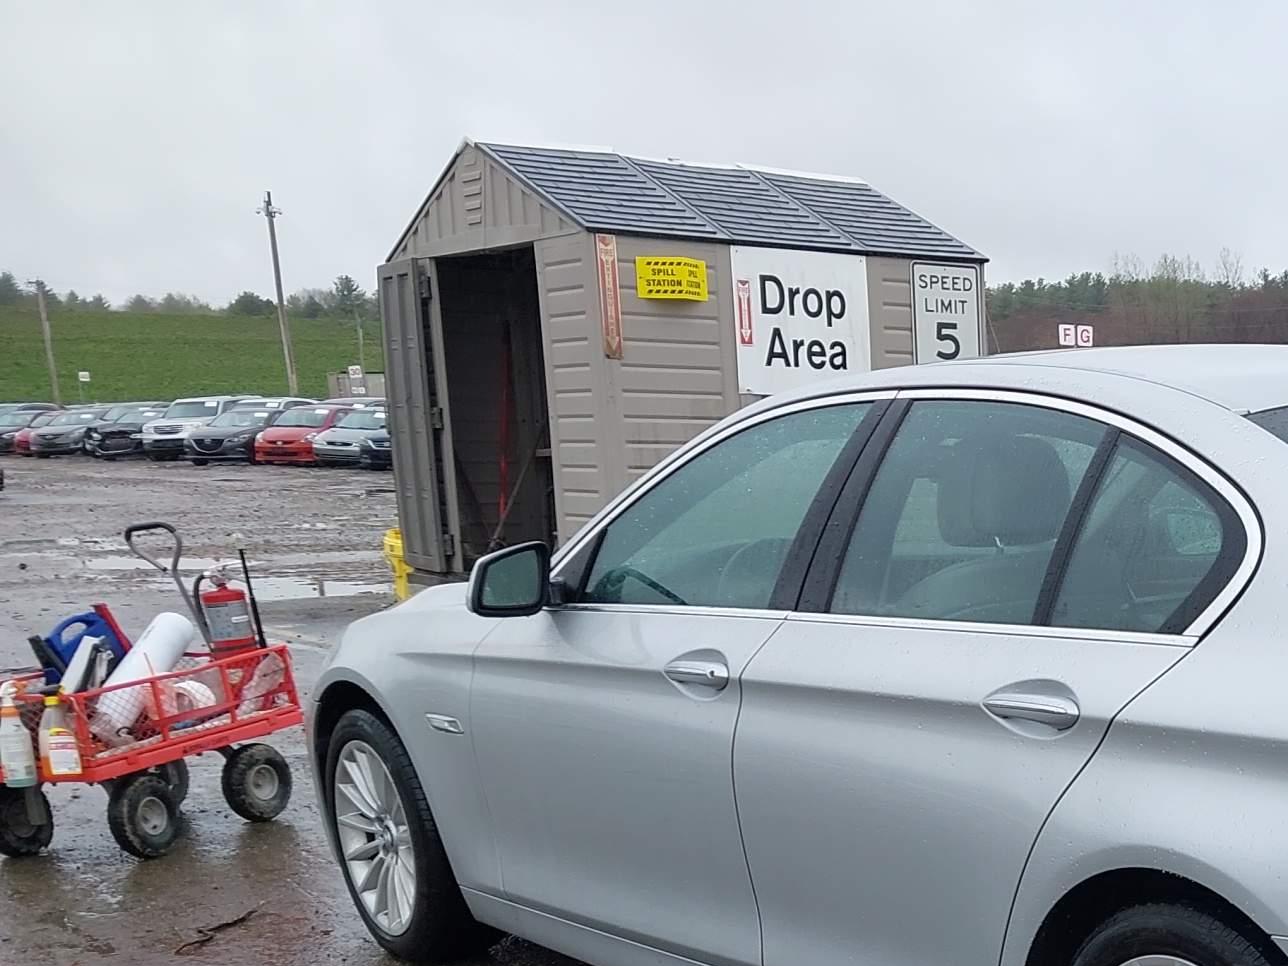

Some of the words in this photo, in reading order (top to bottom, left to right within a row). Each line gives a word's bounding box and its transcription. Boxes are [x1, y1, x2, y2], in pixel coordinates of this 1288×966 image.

[651, 268, 676, 276] SPILL
[646, 279, 682, 287] STATION
[918, 273, 973, 291] SPEED
[759, 274, 846, 327] Drop
[924, 297, 968, 314] LIMIT
[936, 321, 960, 360] 5
[1063, 327, 1071, 342] F
[1080, 328, 1091, 343] G
[765, 327, 848, 370] Area
